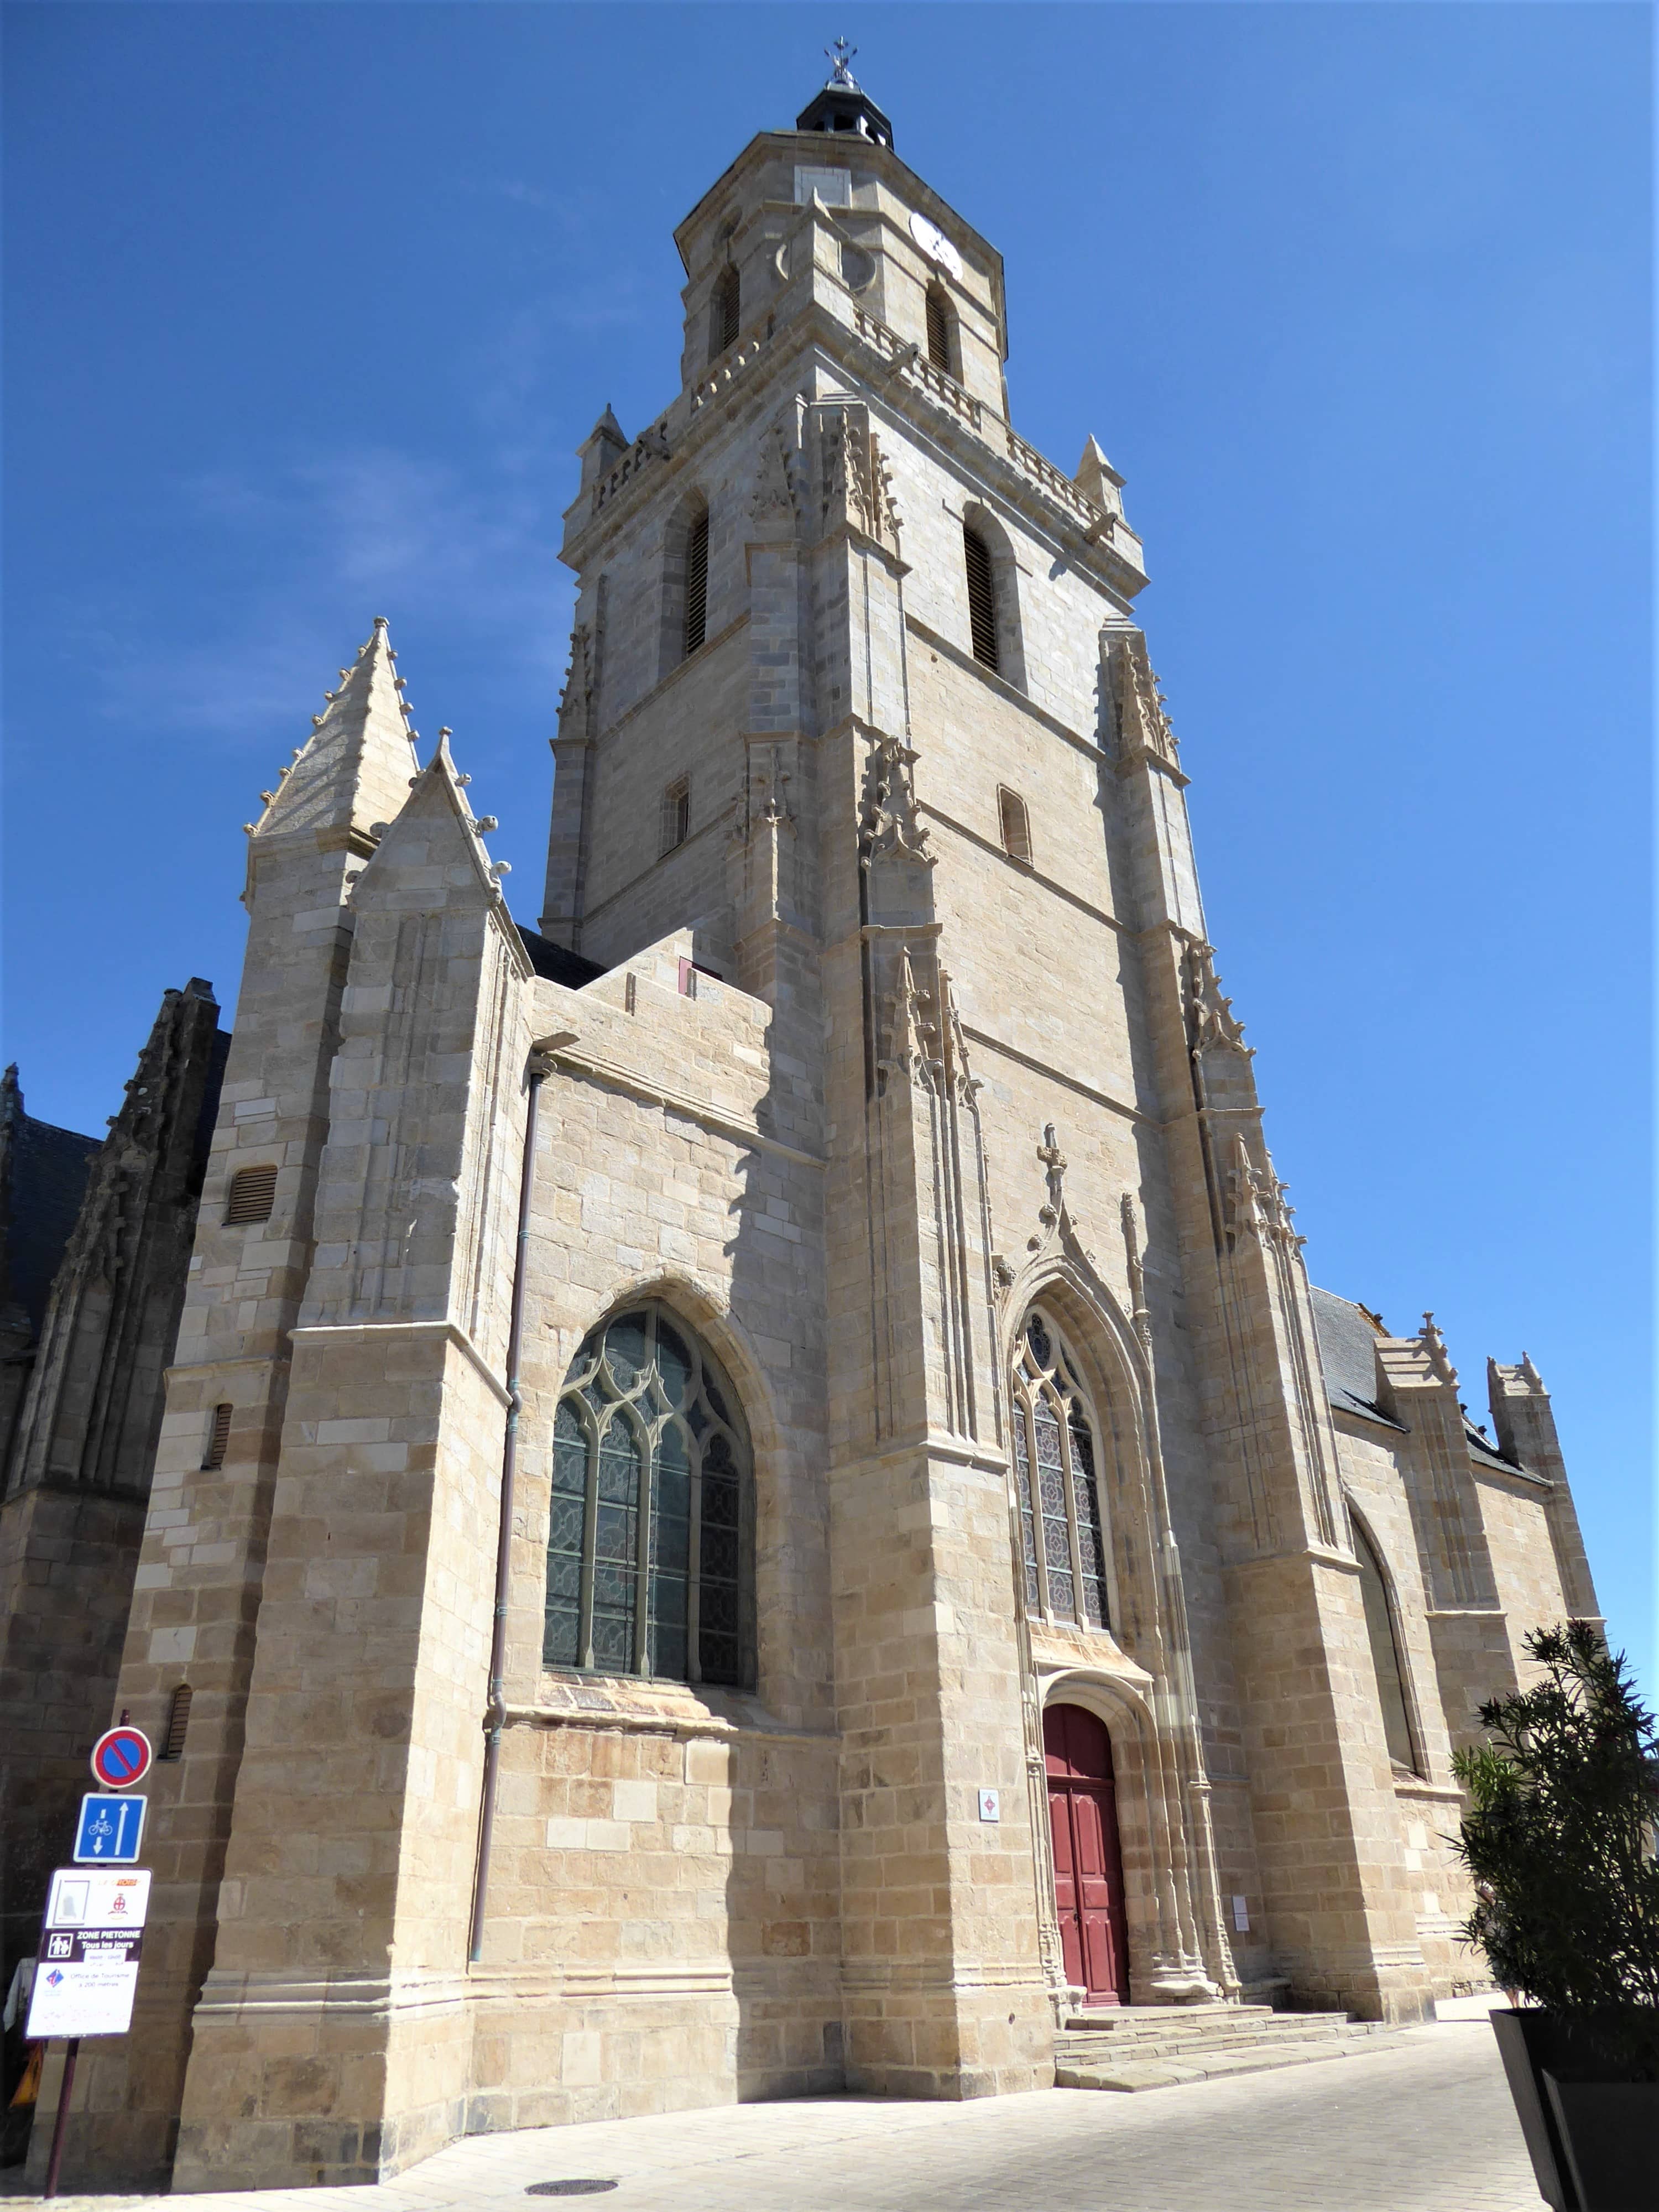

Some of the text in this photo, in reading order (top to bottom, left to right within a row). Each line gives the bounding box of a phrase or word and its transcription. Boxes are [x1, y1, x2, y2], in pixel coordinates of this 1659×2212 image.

[77, 1931, 140, 1939] ZONE PIETONNE
[113, 1940, 134, 1949] jours
